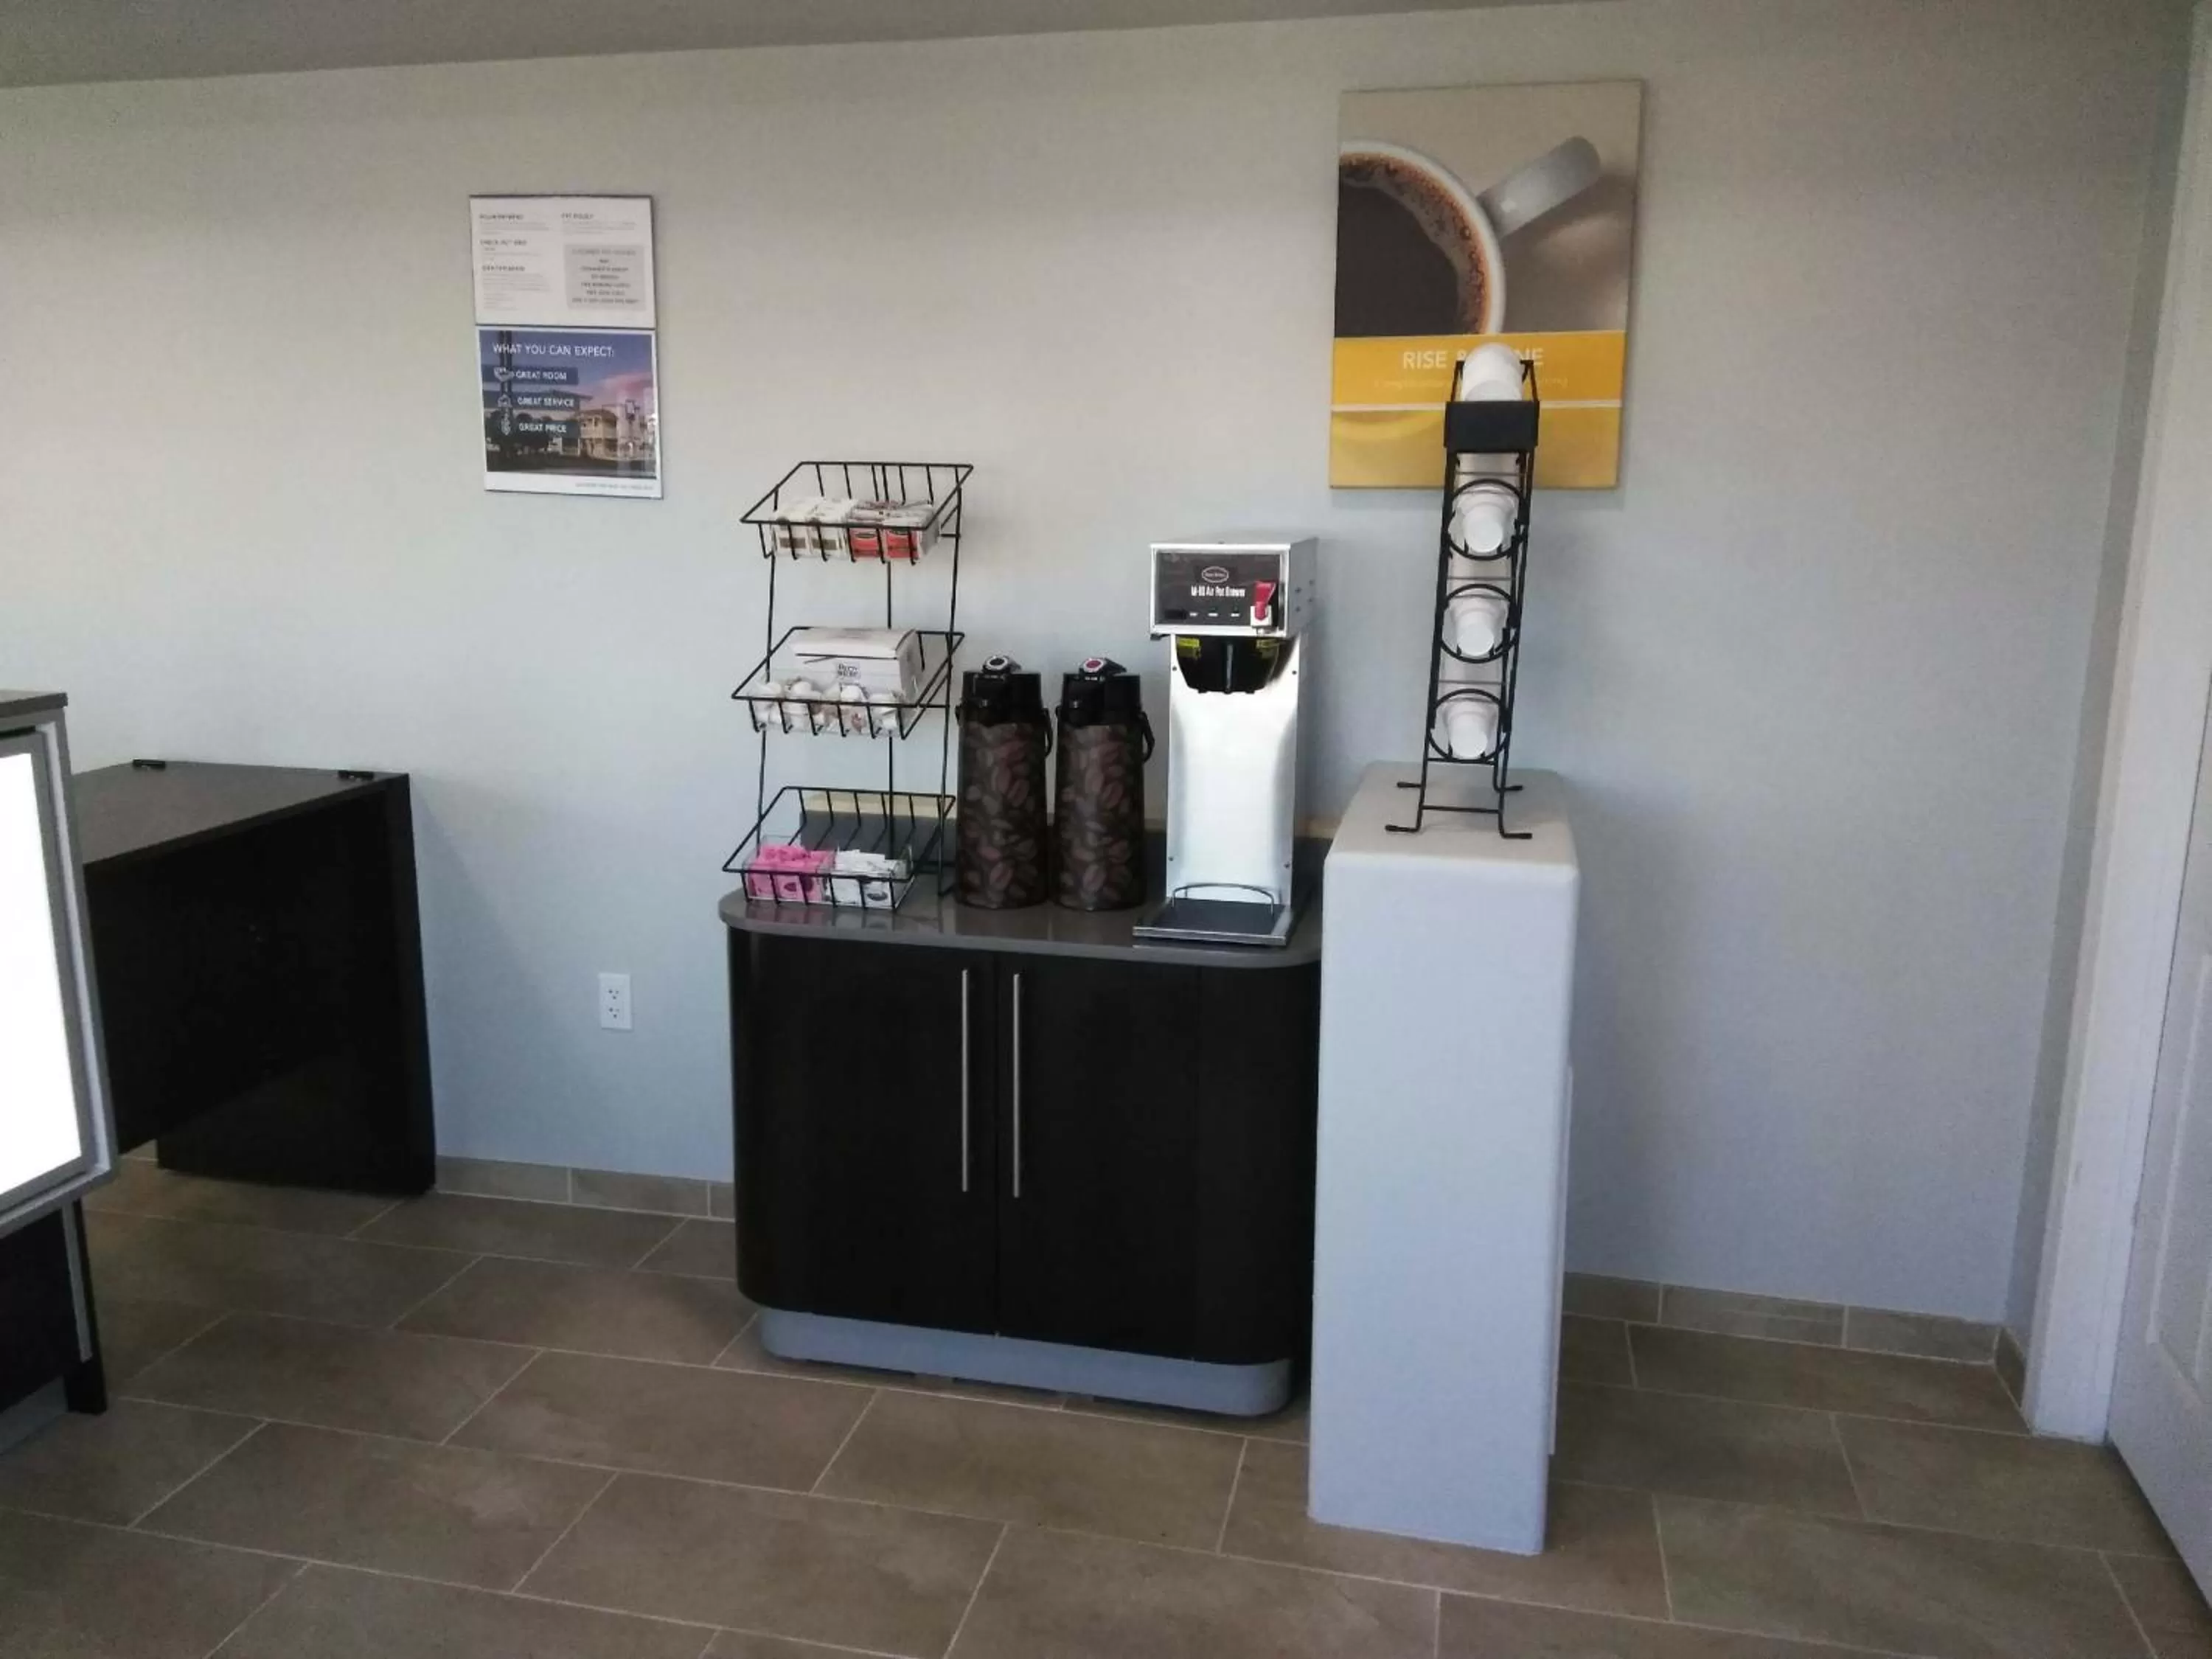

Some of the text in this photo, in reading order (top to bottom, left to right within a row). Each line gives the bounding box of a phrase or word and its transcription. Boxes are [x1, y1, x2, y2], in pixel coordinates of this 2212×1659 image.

[493, 343, 521, 354] WHAT
[525, 344, 546, 355] YOU
[549, 345, 571, 355] CAN
[1403, 351, 1447, 369] RISE
[516, 369, 567, 380] GREAT ROOM
[518, 397, 574, 407] GREAT SERVICE
[518, 422, 566, 434] GREAT PRICE
